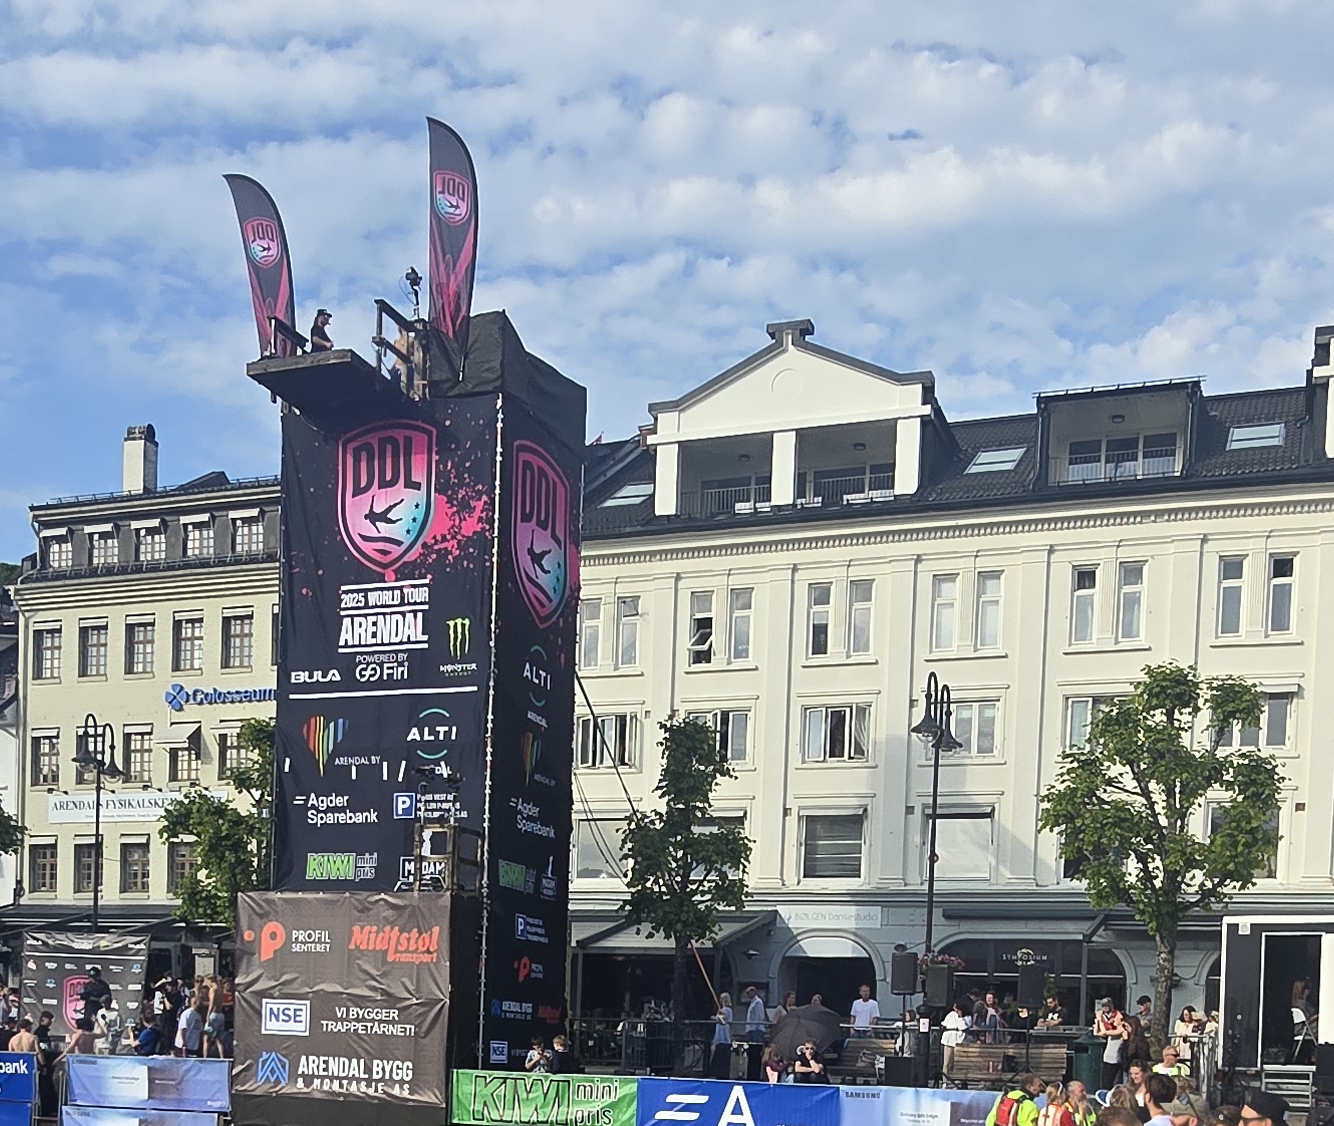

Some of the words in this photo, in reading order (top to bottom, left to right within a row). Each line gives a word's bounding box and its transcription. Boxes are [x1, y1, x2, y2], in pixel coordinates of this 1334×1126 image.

[351, 435, 422, 499] DDL
[520, 459, 563, 550] DDL
[340, 592, 365, 608] 2025
[367, 589, 401, 607] WORLD
[402, 586, 429, 604] TOUR
[338, 611, 429, 647] ARENDAL
[355, 653, 396, 663] POWERED
[397, 652, 408, 662] BY
[290, 669, 341, 684] BULA
[383, 662, 408, 681] Firi
[439, 663, 478, 673] MONSTER
[523, 661, 551, 691] ALTI
[406, 725, 457, 741] ALTI
[334, 757, 368, 765] ARENDAL
[369, 755, 381, 764] BY
[105, 798, 166, 810] FYSIKALSKE
[307, 792, 350, 810] Agder
[516, 797, 540, 818] Agder
[307, 809, 379, 827] Sparebank
[516, 814, 556, 839] Sparebank
[306, 853, 356, 880] KIWI
[357, 852, 377, 867] mini
[355, 866, 376, 881] pris
[404, 861, 446, 877] MDAM
[291, 929, 331, 943] PROFIL
[349, 925, 440, 959] Midtstøl
[291, 943, 330, 952] SENTERET
[268, 1006, 304, 1024] NSE
[335, 1006, 347, 1018] VI
[349, 1007, 399, 1021] BYGGER
[491, 1044, 507, 1058] NSE
[298, 1055, 369, 1079] ARENDAL
[372, 1059, 413, 1082] BYGG
[313, 1078, 385, 1094] MONTASJE
[392, 1083, 410, 1095] AS
[845, 1091, 881, 1099] SAMSUNG
[472, 1075, 571, 1126] KIWI
[576, 1078, 620, 1101] mini
